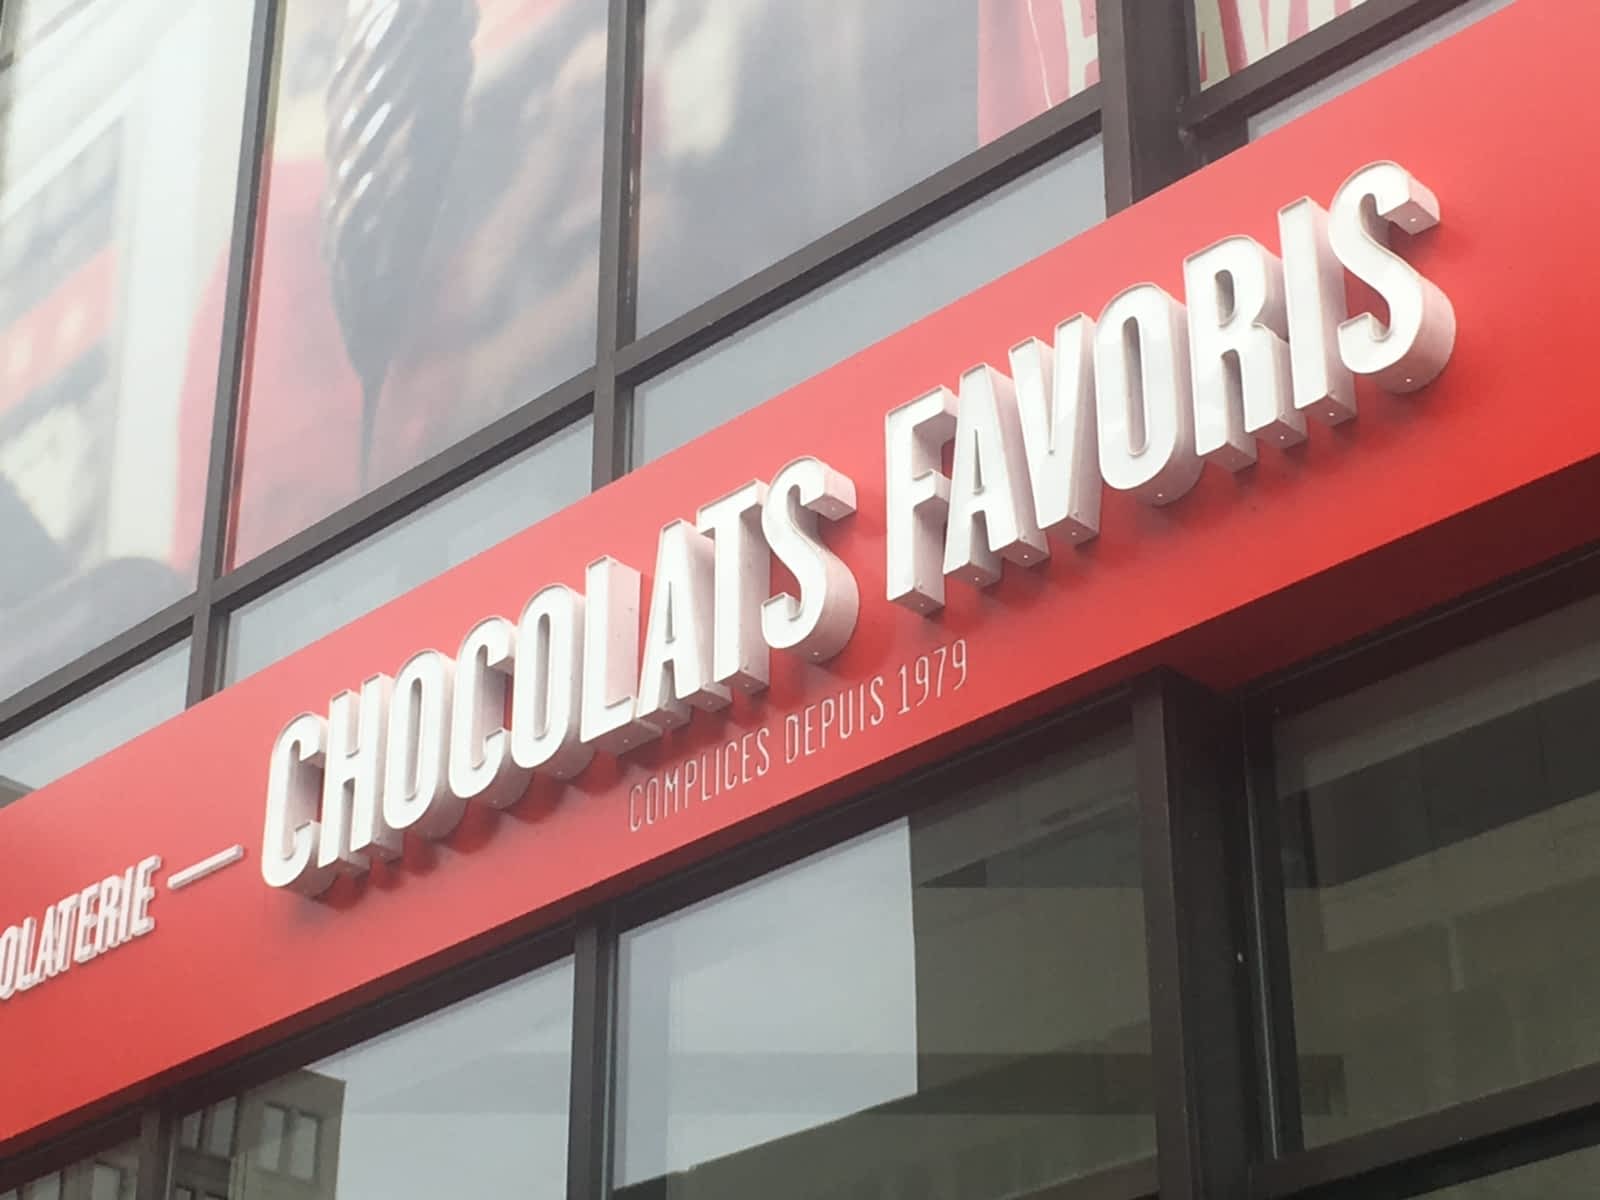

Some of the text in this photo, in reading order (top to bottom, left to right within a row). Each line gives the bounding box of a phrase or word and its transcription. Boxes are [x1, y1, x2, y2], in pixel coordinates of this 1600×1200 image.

[261, 160, 1456, 898] CHOCOLATS FAVORIS
[629, 639, 968, 833] COMPLICES DEPUIS 1979
